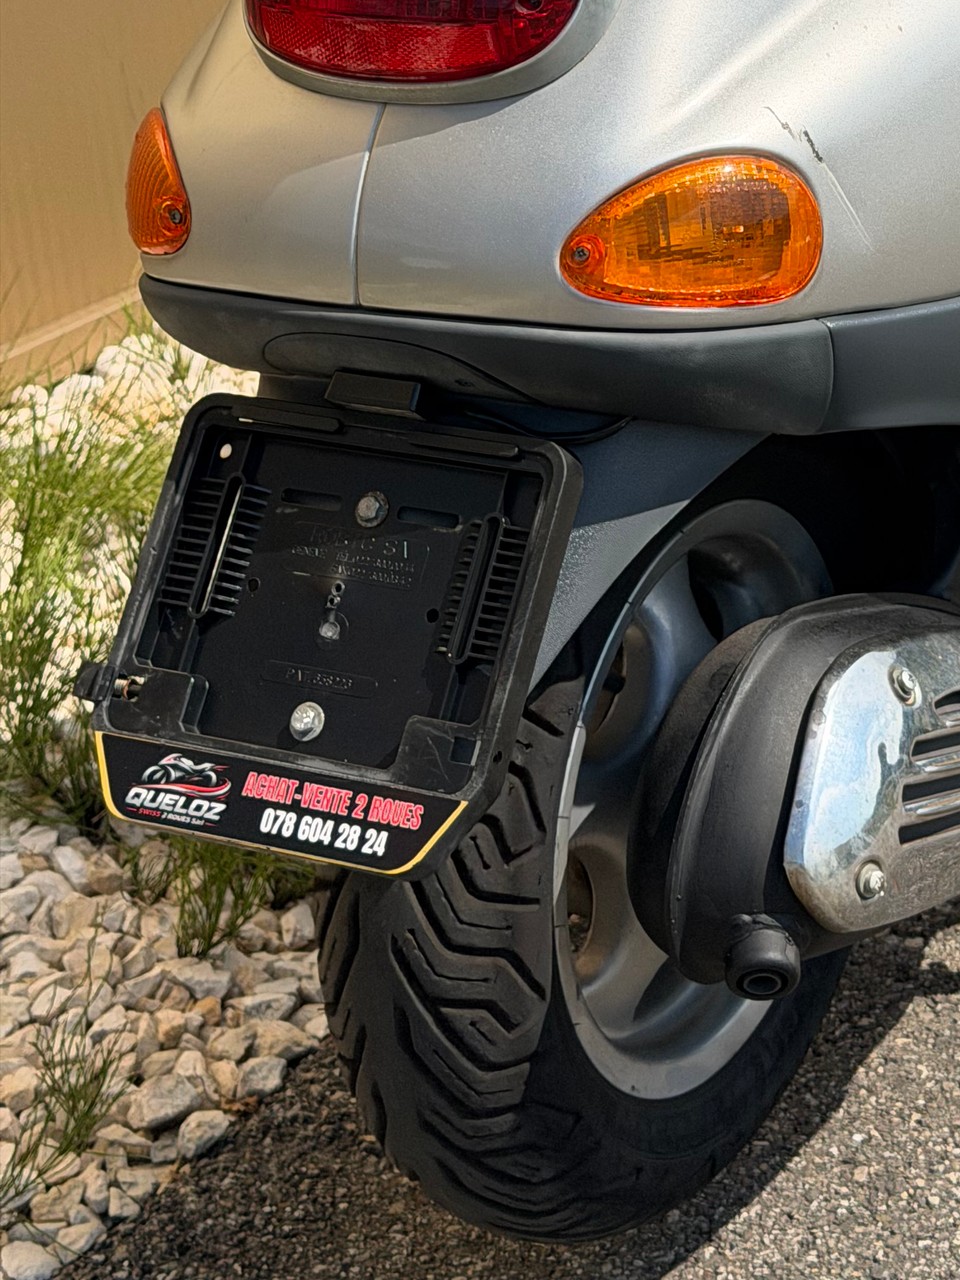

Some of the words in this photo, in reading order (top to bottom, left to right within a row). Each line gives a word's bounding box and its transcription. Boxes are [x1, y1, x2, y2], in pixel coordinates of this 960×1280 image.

[125, 787, 227, 820] QUELOZ
[138, 807, 161, 817] SWISS
[242, 771, 353, 816] ACHAT-VENTE
[352, 793, 369, 819] 2
[367, 796, 424, 830] ROUES
[259, 808, 297, 838] 078
[297, 815, 335, 845] 604
[334, 822, 361, 851] 28
[361, 828, 389, 856] 24
